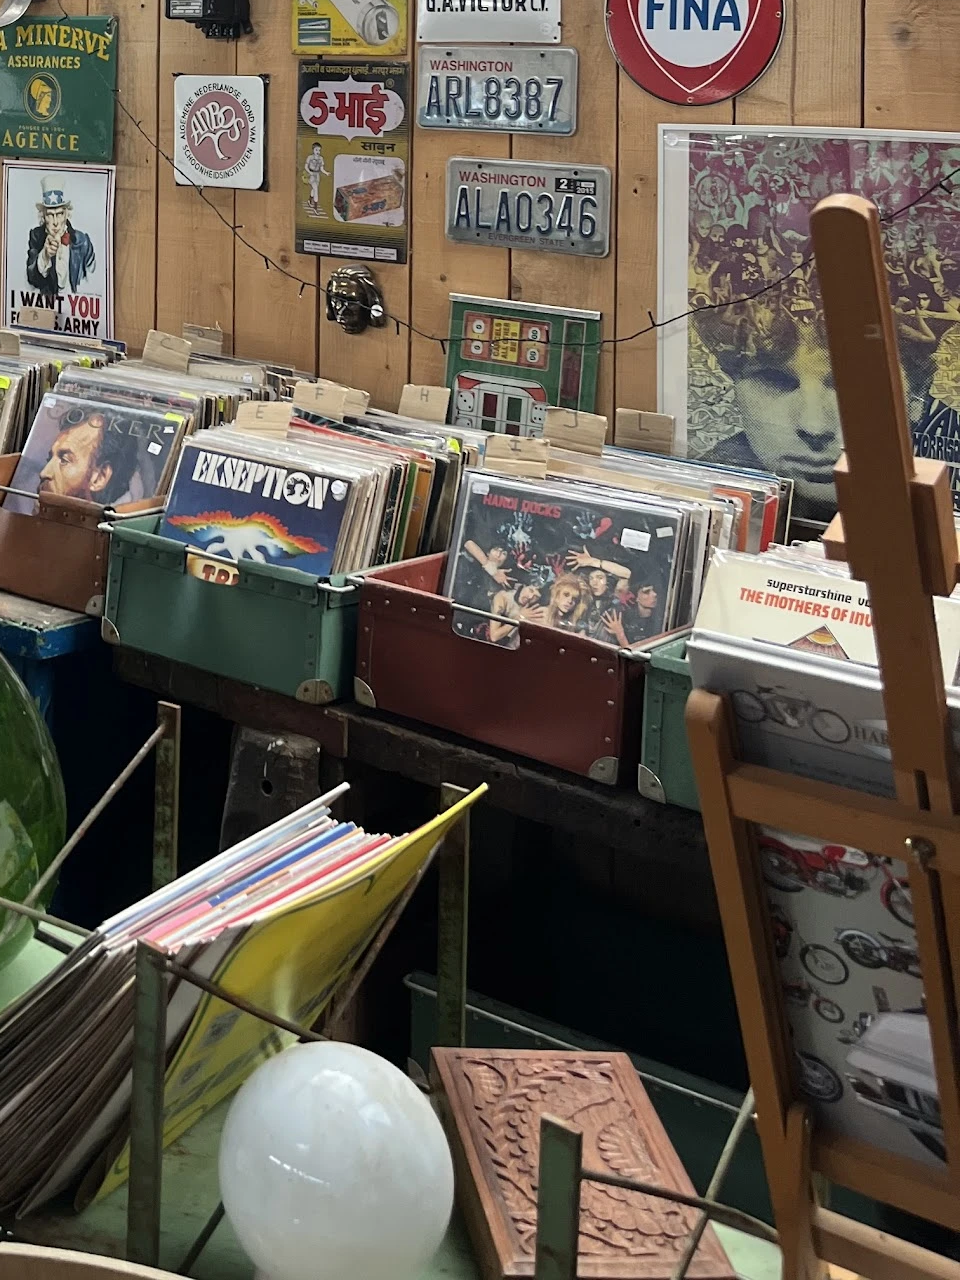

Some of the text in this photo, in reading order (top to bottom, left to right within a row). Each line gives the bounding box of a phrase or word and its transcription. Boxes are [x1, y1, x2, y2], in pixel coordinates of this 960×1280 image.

[15, 24, 112, 61] MINERVE
[8, 55, 81, 69] ASSURANCES
[430, 60, 513, 72] WASHINGTON
[425, 73, 563, 121] ARL8387
[180, 97, 195, 140] ALGEMENE
[194, 83, 242, 100] NEDERLANDSE
[241, 99, 255, 123] BOND
[2, 129, 79, 152] AGENCE
[182, 144, 253, 179] SCHOONHEIDSINSTITUTEN
[459, 171, 546, 188] WASHINGTON
[453, 185, 598, 239] ALA0346
[488, 233, 564, 247] EVERGREEN STATE
[11, 290, 100, 320] I WANT YOU
[63, 317, 100, 336] ARMY
[160, 338, 179, 350] C
[315, 387, 324, 399] F
[420, 391, 429, 402] H
[255, 404, 269, 419] E
[563, 410, 578, 429] J
[47, 405, 165, 444] COCKER
[638, 412, 649, 431] L
[509, 439, 521, 452] I
[192, 451, 330, 510] EKSEPTION
[767, 578, 852, 604] superstarshine
[739, 587, 873, 627] THE MOTHERS OF INV
